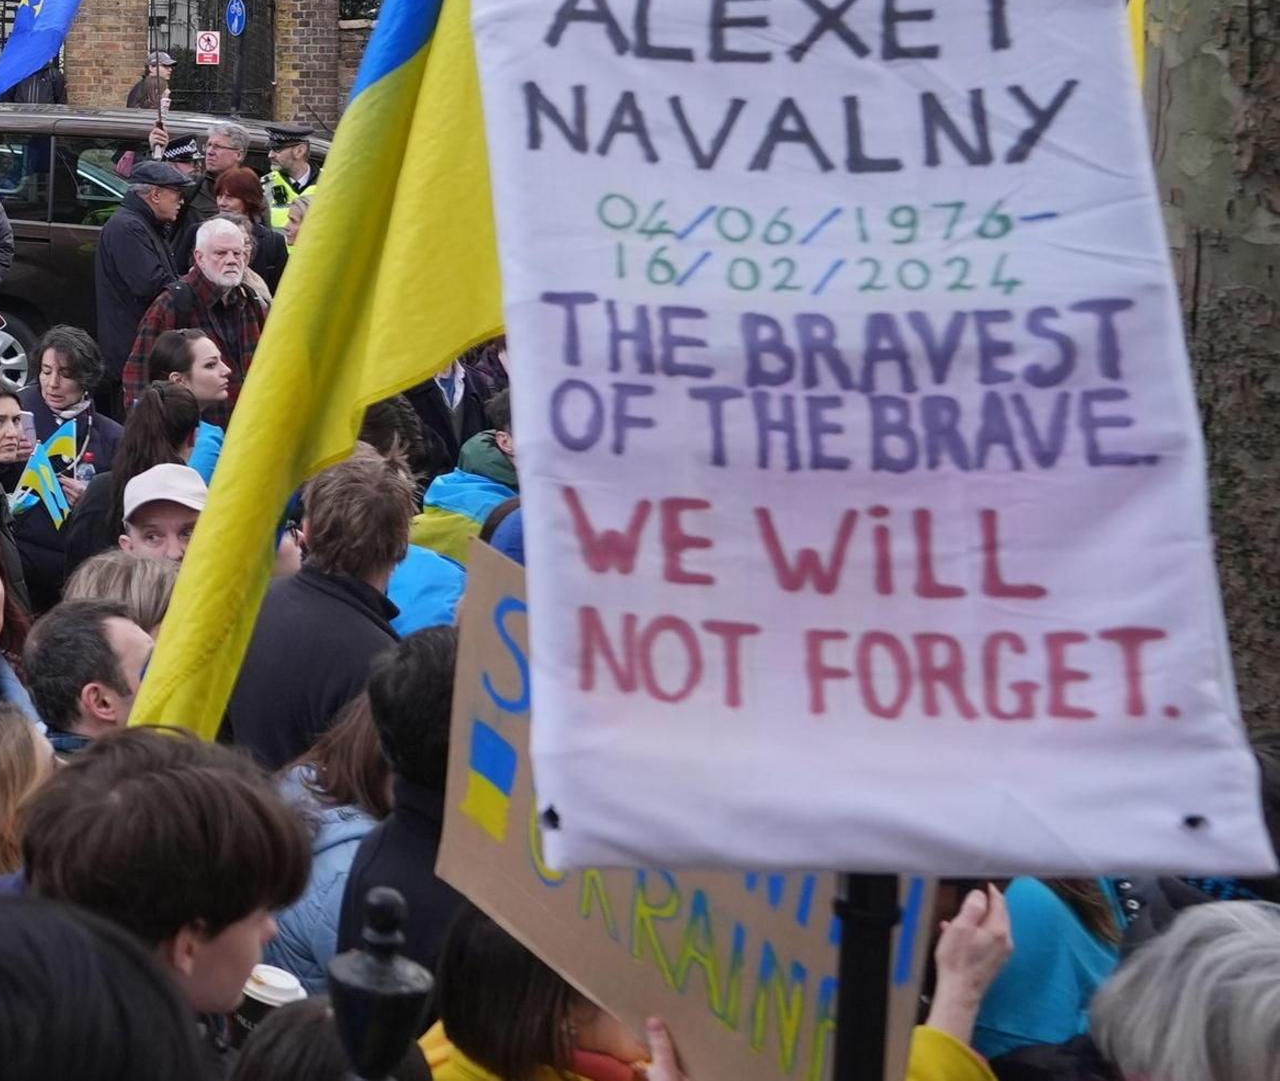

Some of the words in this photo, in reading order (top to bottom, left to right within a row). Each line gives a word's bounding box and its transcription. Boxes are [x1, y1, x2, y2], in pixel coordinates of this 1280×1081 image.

[521, 79, 1079, 175] NAVALNY
[539, 291, 715, 380] THE
[744, 298, 1135, 393] BRAVEST
[551, 378, 655, 457] OF
[689, 387, 851, 473] THE
[563, 486, 716, 587] WE
[579, 606, 762, 710] NOT
[806, 625, 1182, 722] FORGET.
